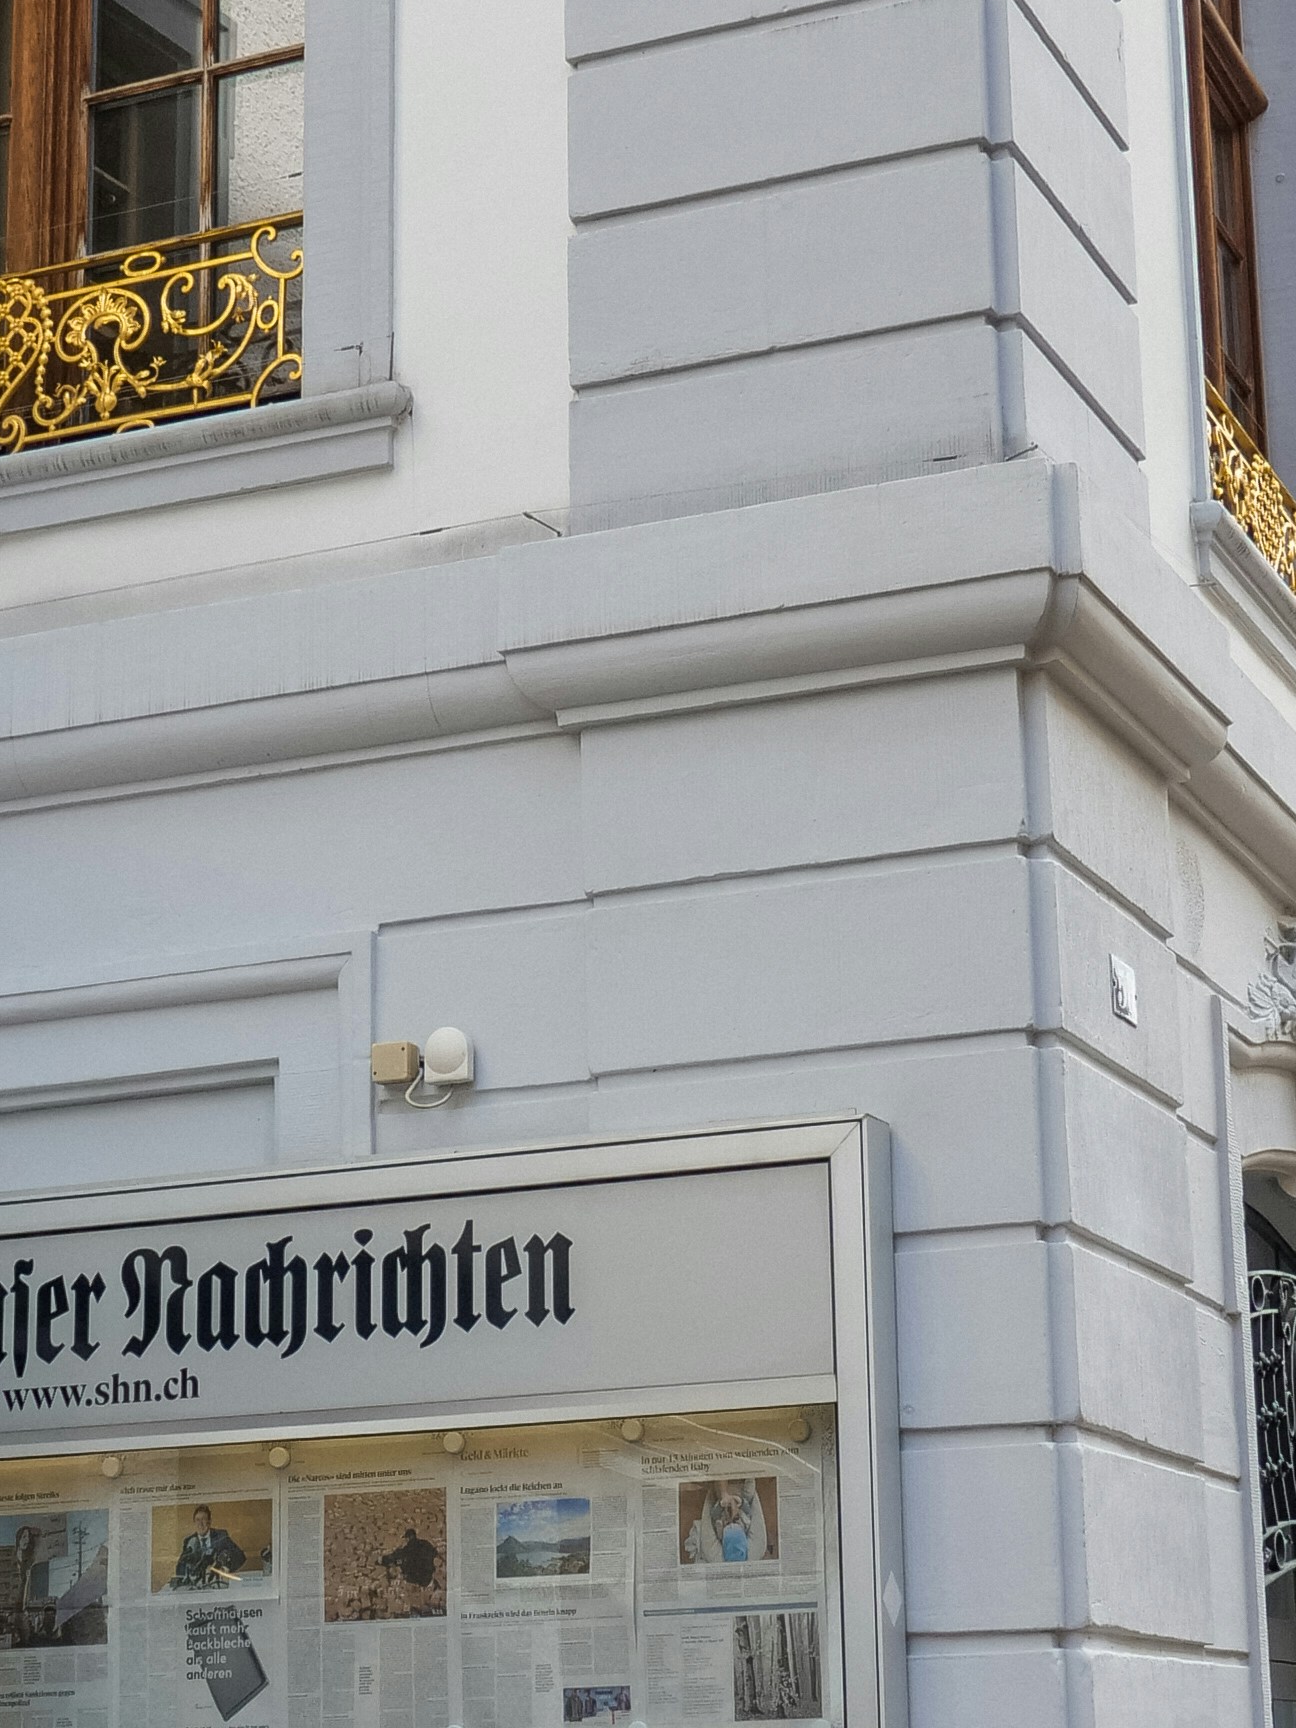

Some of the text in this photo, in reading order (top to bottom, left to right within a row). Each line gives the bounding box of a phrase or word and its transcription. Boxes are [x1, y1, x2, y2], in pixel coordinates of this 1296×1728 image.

[121, 1219, 576, 1359] Nachrichten
[2, 1367, 199, 1412] www.shn.ch
[186, 1606, 263, 1621] Schaffhausen
[185, 1621, 249, 1636] kauft mehr
[187, 1636, 252, 1651] Backbleche
[186, 1651, 227, 1666] als alle
[186, 1667, 233, 1681] anderen
